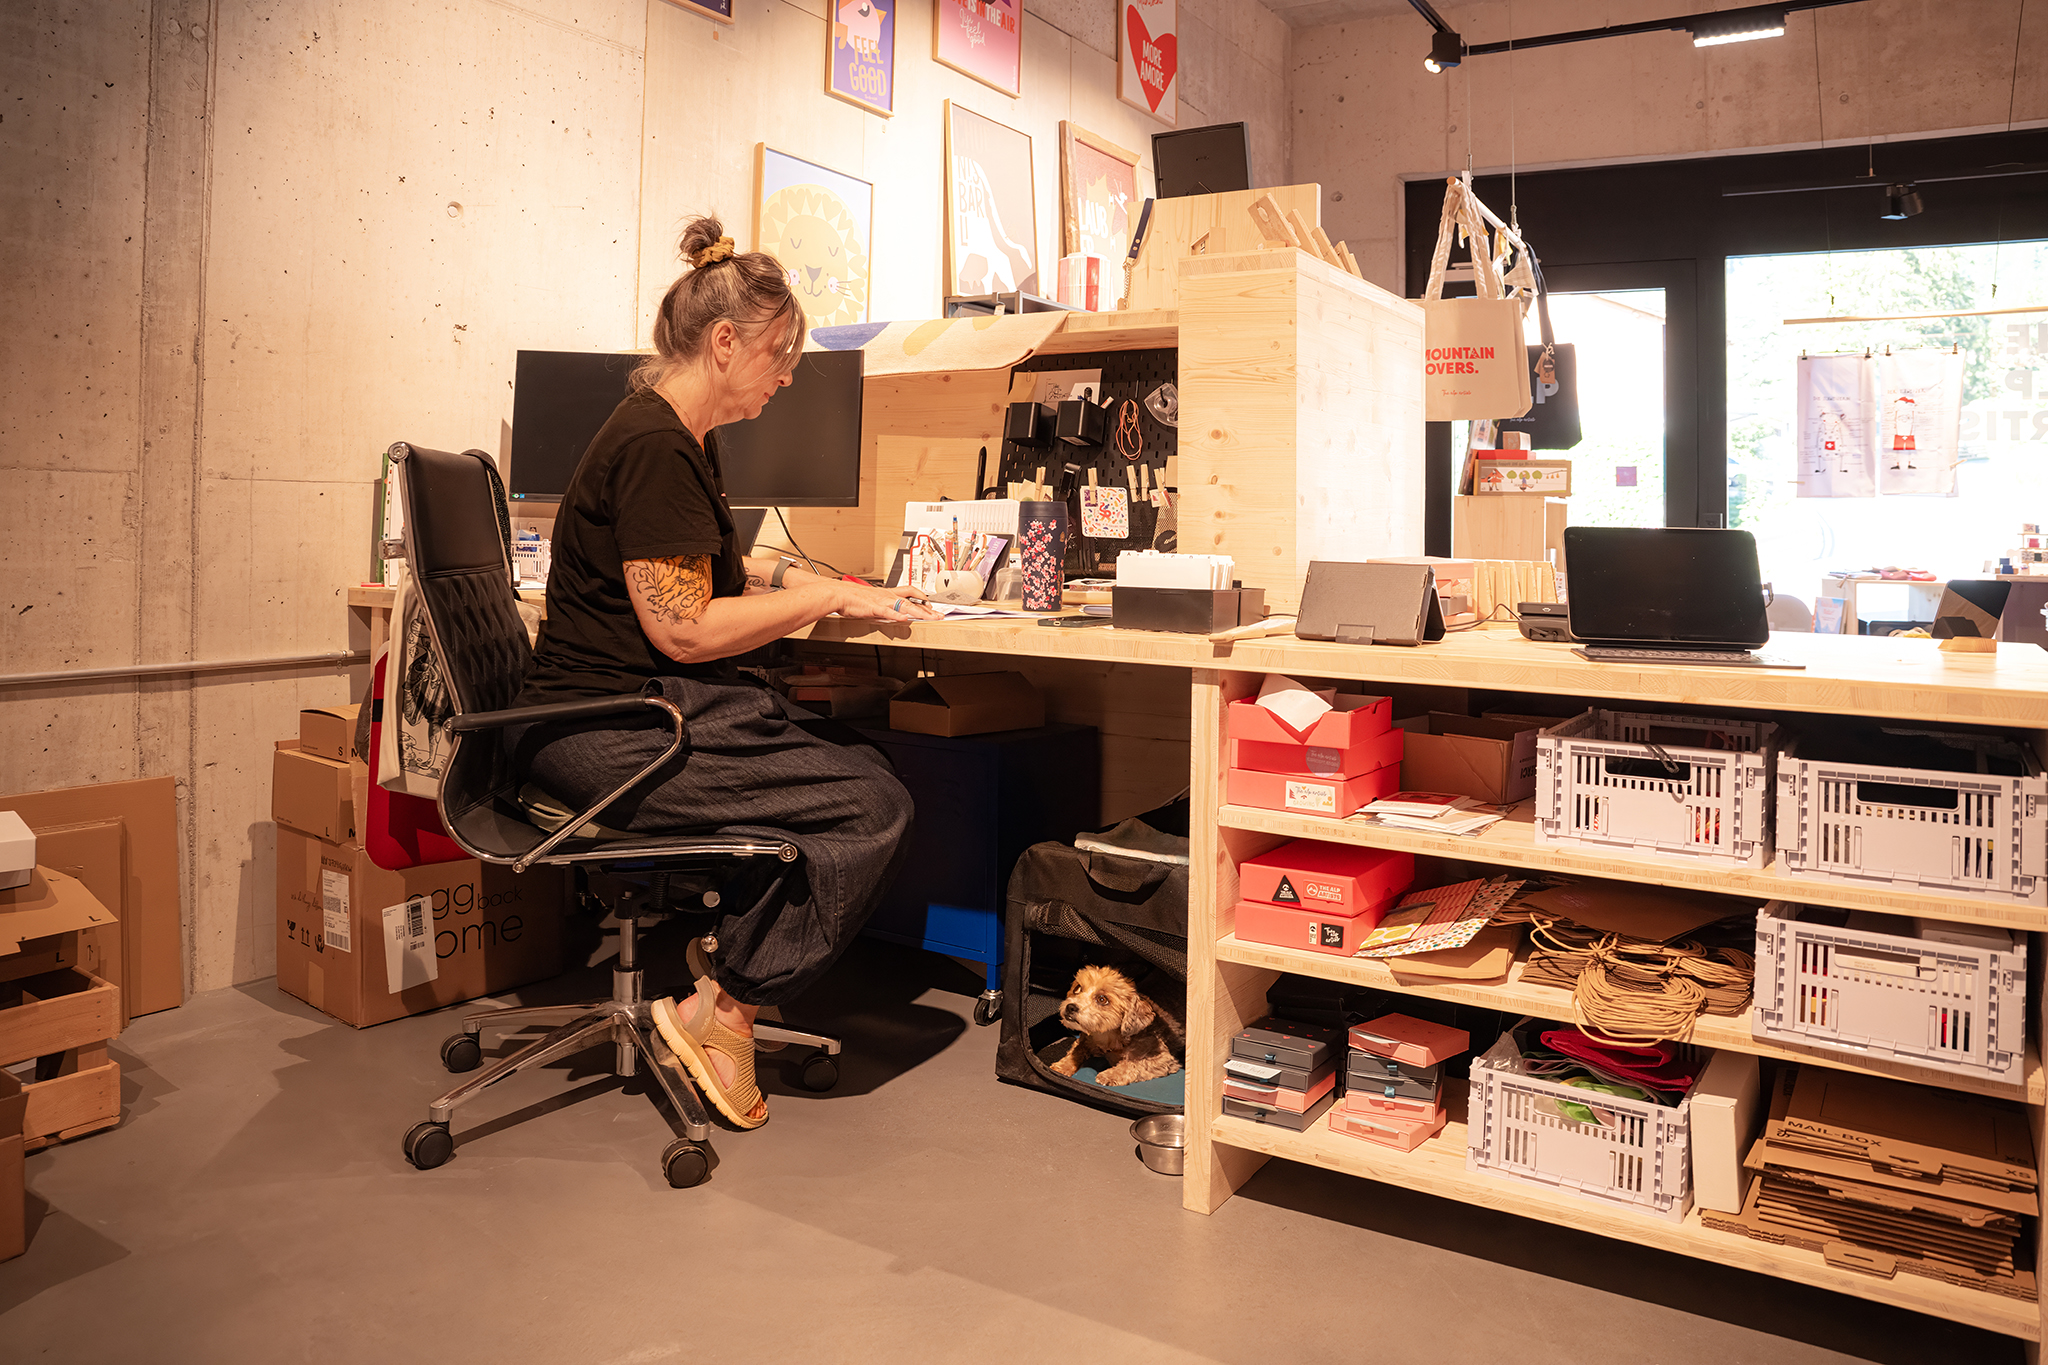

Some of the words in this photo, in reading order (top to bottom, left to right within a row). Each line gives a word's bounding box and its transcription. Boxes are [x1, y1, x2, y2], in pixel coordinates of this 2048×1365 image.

[985, 3, 1001, 27] THE
[1001, 12, 1016, 34] AIR
[853, 34, 884, 65] FEEL
[1142, 39, 1163, 69] MORE
[848, 62, 887, 97] GOOD
[1140, 60, 1164, 92] AMORE
[1078, 196, 1108, 239] LAUB
[1425, 362, 1479, 376] OVERS.
[337, 746, 344, 757] S
[1520, 765, 1536, 779] ERCI
[325, 826, 330, 837] L
[477, 885, 523, 910] back
[435, 915, 524, 959] ome
[1787, 1120, 1883, 1148] MAIL-BOX
[2005, 1154, 2029, 1165] XS
[2005, 1168, 2031, 1179] XS
